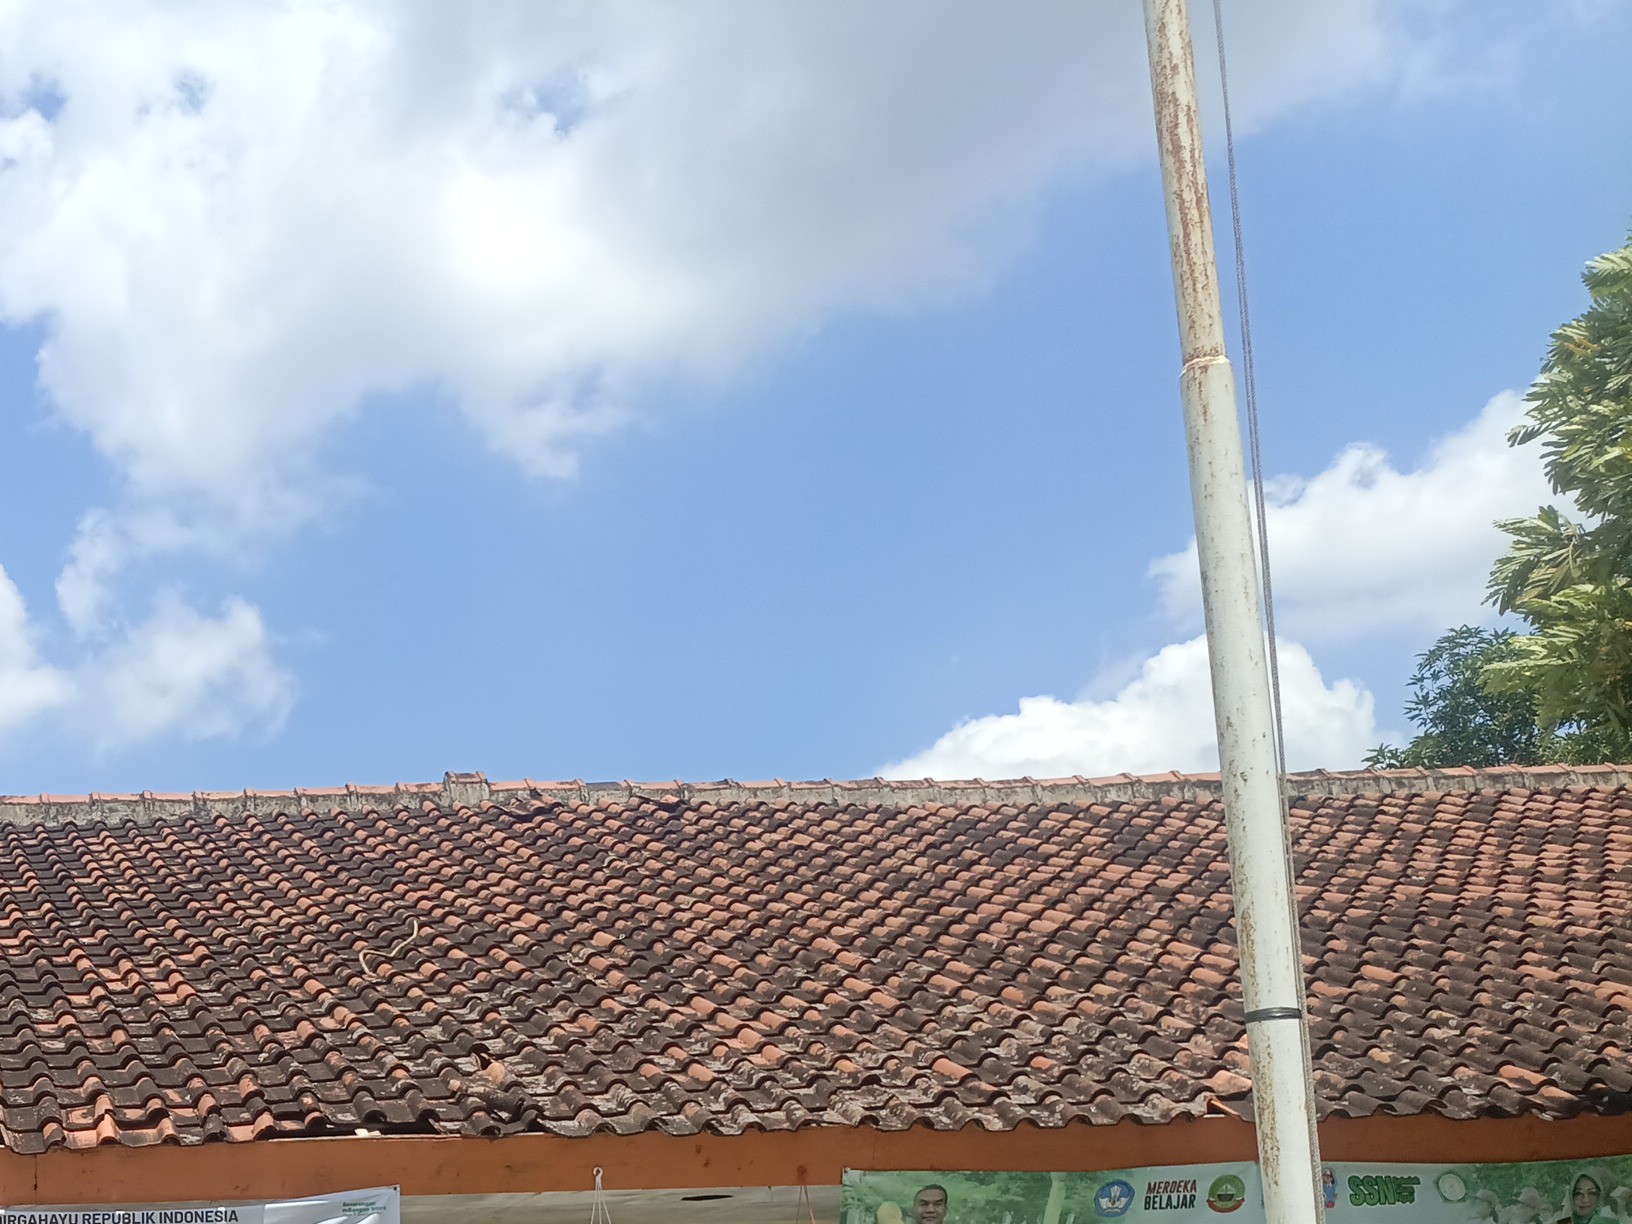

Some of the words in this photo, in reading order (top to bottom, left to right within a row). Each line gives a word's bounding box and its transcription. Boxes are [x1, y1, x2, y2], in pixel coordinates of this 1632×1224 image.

[1146, 1179, 1197, 1195] MERDEKA
[1348, 1175, 1396, 1206] SSN
[1144, 1194, 1196, 1211] BELAJAR
[158, 1209, 239, 1224] INDONESIA
